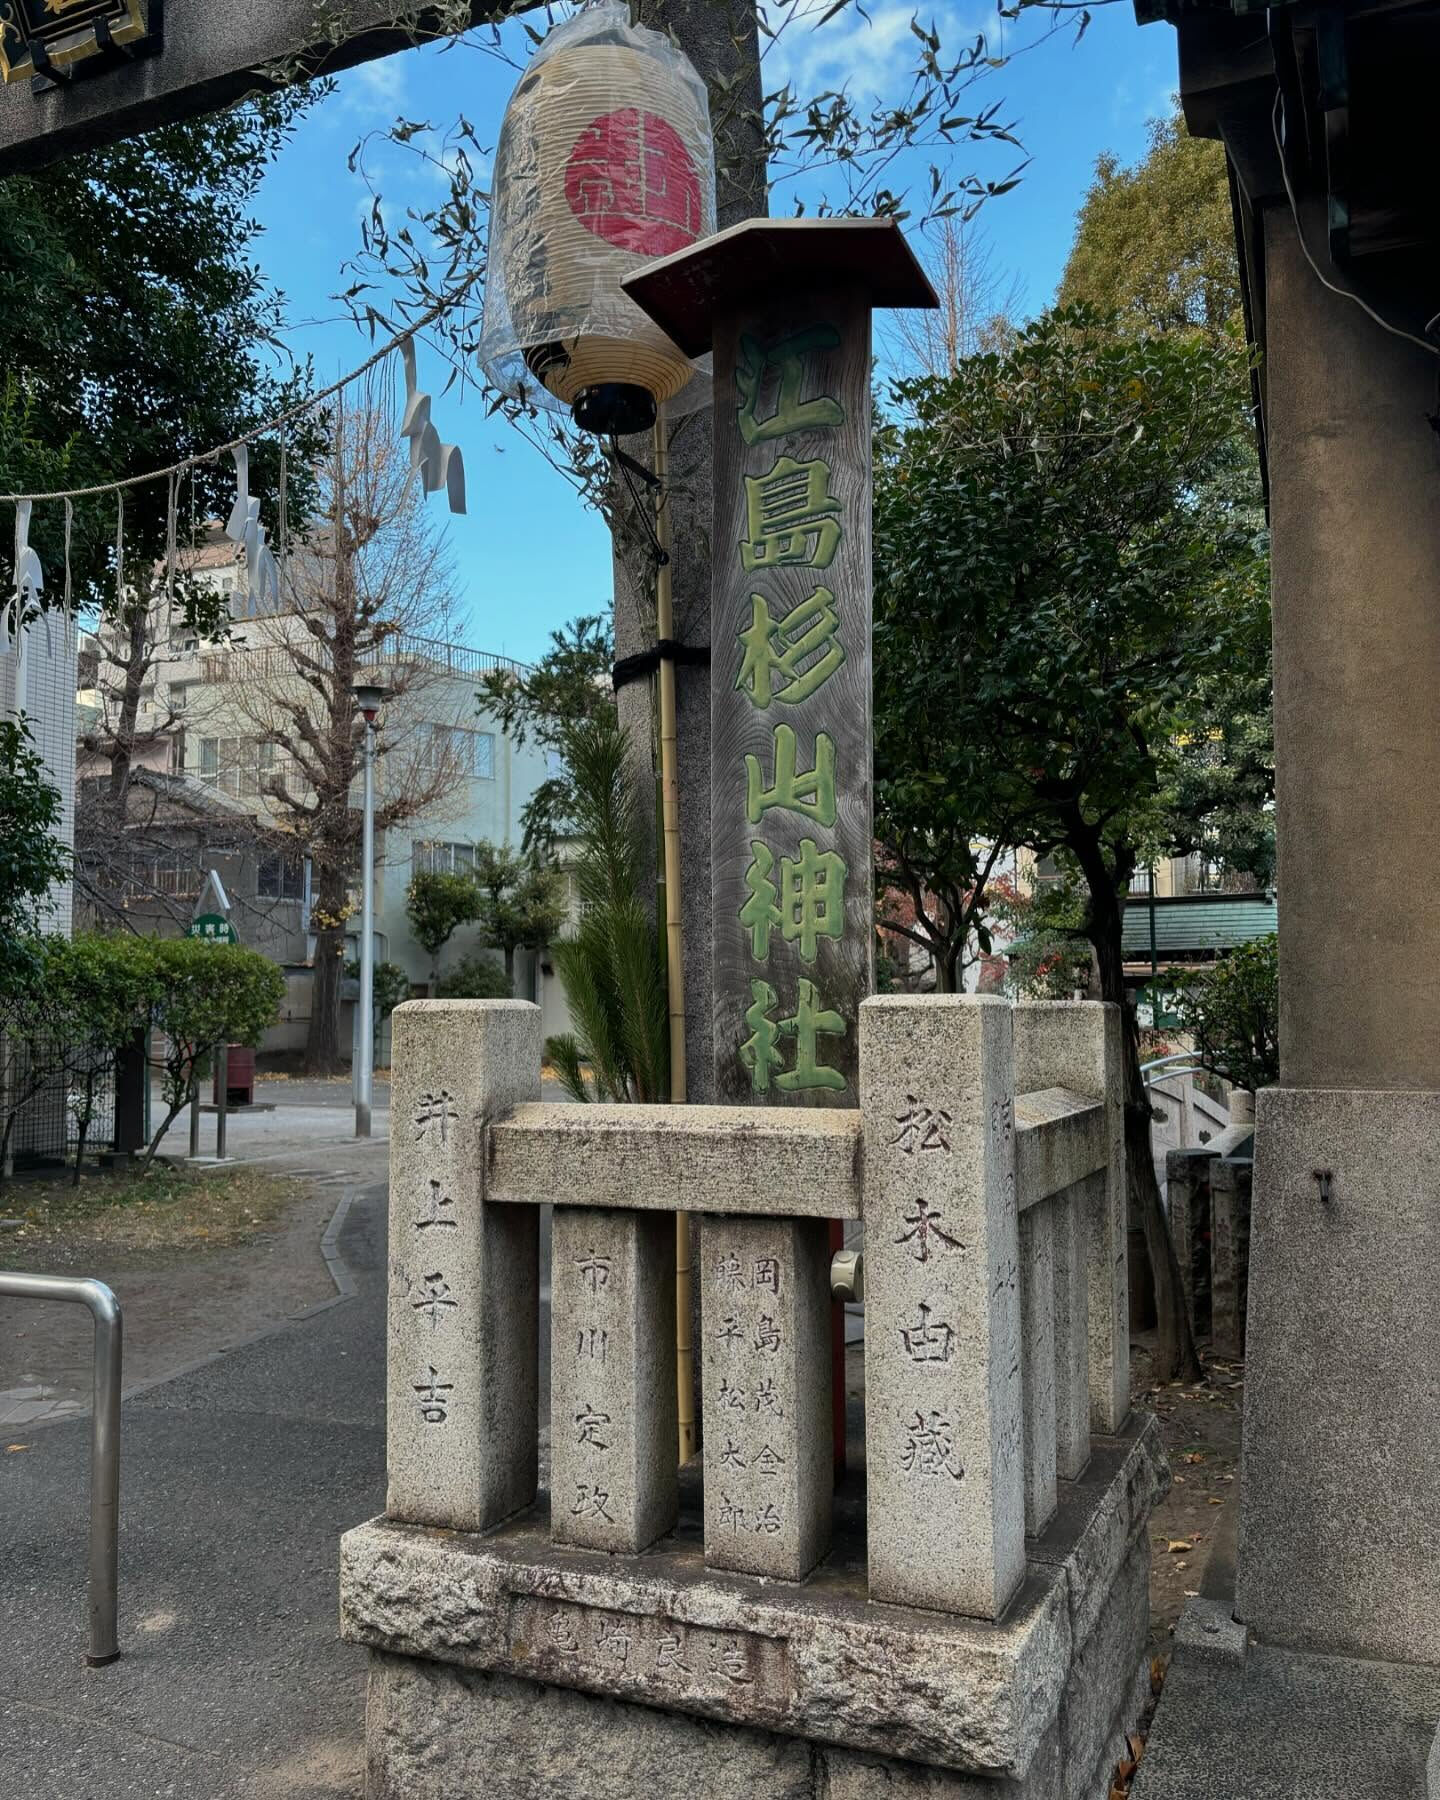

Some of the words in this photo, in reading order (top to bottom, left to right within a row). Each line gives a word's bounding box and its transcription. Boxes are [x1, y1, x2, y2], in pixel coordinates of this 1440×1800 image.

[734, 321, 848, 1096] 江島杉山神社
[413, 1088, 460, 1424] 井上平吉
[571, 1246, 617, 1526] 市川定政
